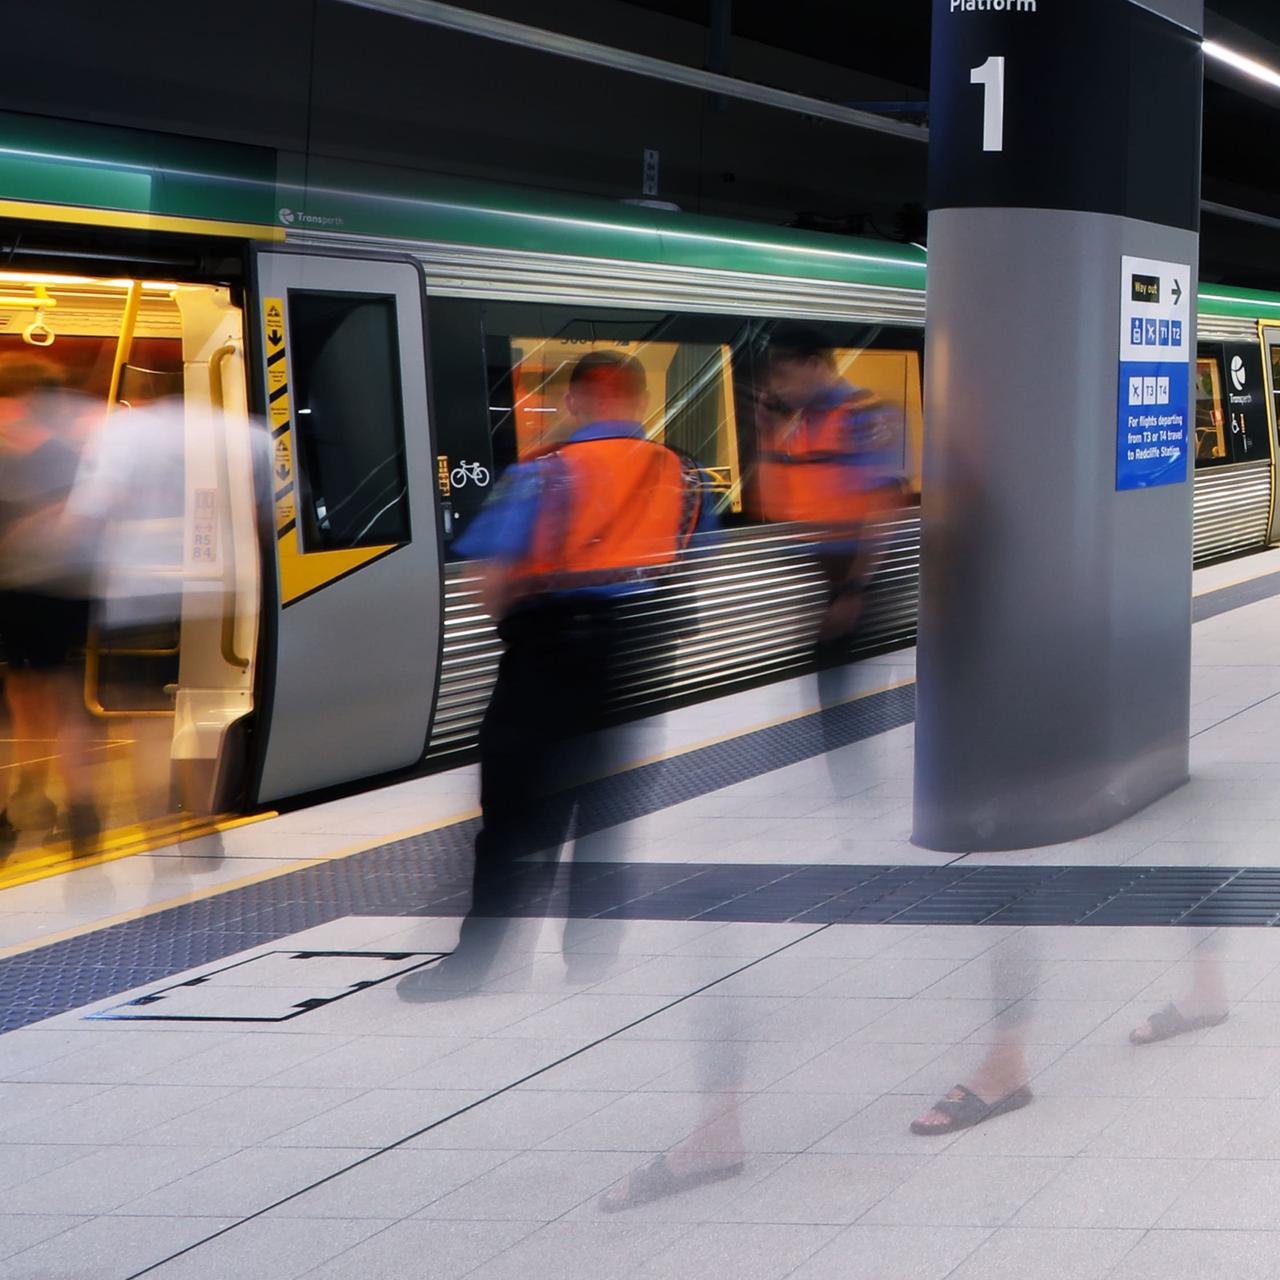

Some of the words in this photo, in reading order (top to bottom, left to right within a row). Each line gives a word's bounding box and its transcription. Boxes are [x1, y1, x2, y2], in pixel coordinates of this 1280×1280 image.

[970, 56, 1005, 152] 1
[1134, 281, 1147, 295] Way
[1147, 283, 1158, 294] out
[1160, 327, 1168, 339] T1
[1172, 327, 1180, 340] T2
[1146, 385, 1154, 396] T3
[1159, 385, 1167, 396] T4
[1128, 416, 1139, 427] For
[1139, 415, 1158, 429] flights
[1158, 413, 1183, 427] departing
[1127, 432, 1142, 444] from
[1143, 431, 1151, 442] T3
[1151, 433, 1159, 442] or
[1159, 430, 1167, 441] T4
[1167, 429, 1183, 441] travel
[1127, 449, 1135, 461] to
[1135, 446, 1160, 460] Redcliffe
[1160, 445, 1180, 457] Station
